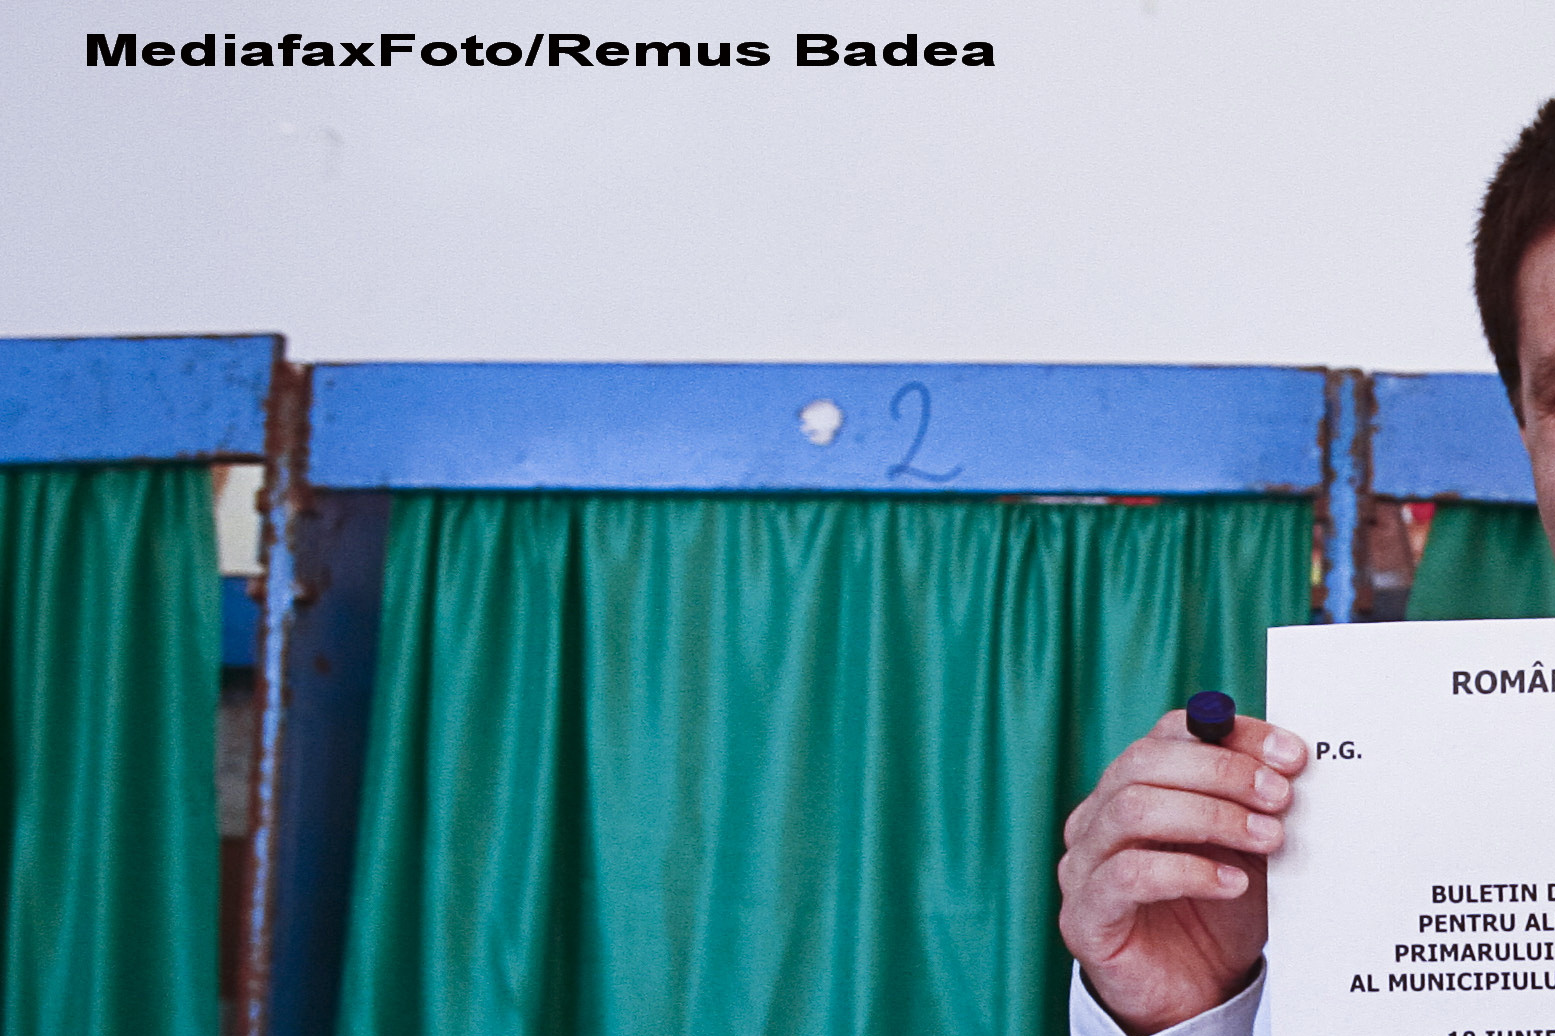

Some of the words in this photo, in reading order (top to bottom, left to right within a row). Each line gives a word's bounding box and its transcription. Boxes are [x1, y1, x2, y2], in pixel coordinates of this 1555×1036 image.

[886, 381, 963, 482] 2
[1316, 741, 1362, 760] P.G.
[1432, 883, 1537, 904] BULETIN
[1419, 913, 1515, 933] PENTRU
[1395, 942, 1554, 963] PRIMARULUI
[1350, 974, 1380, 993] AL
